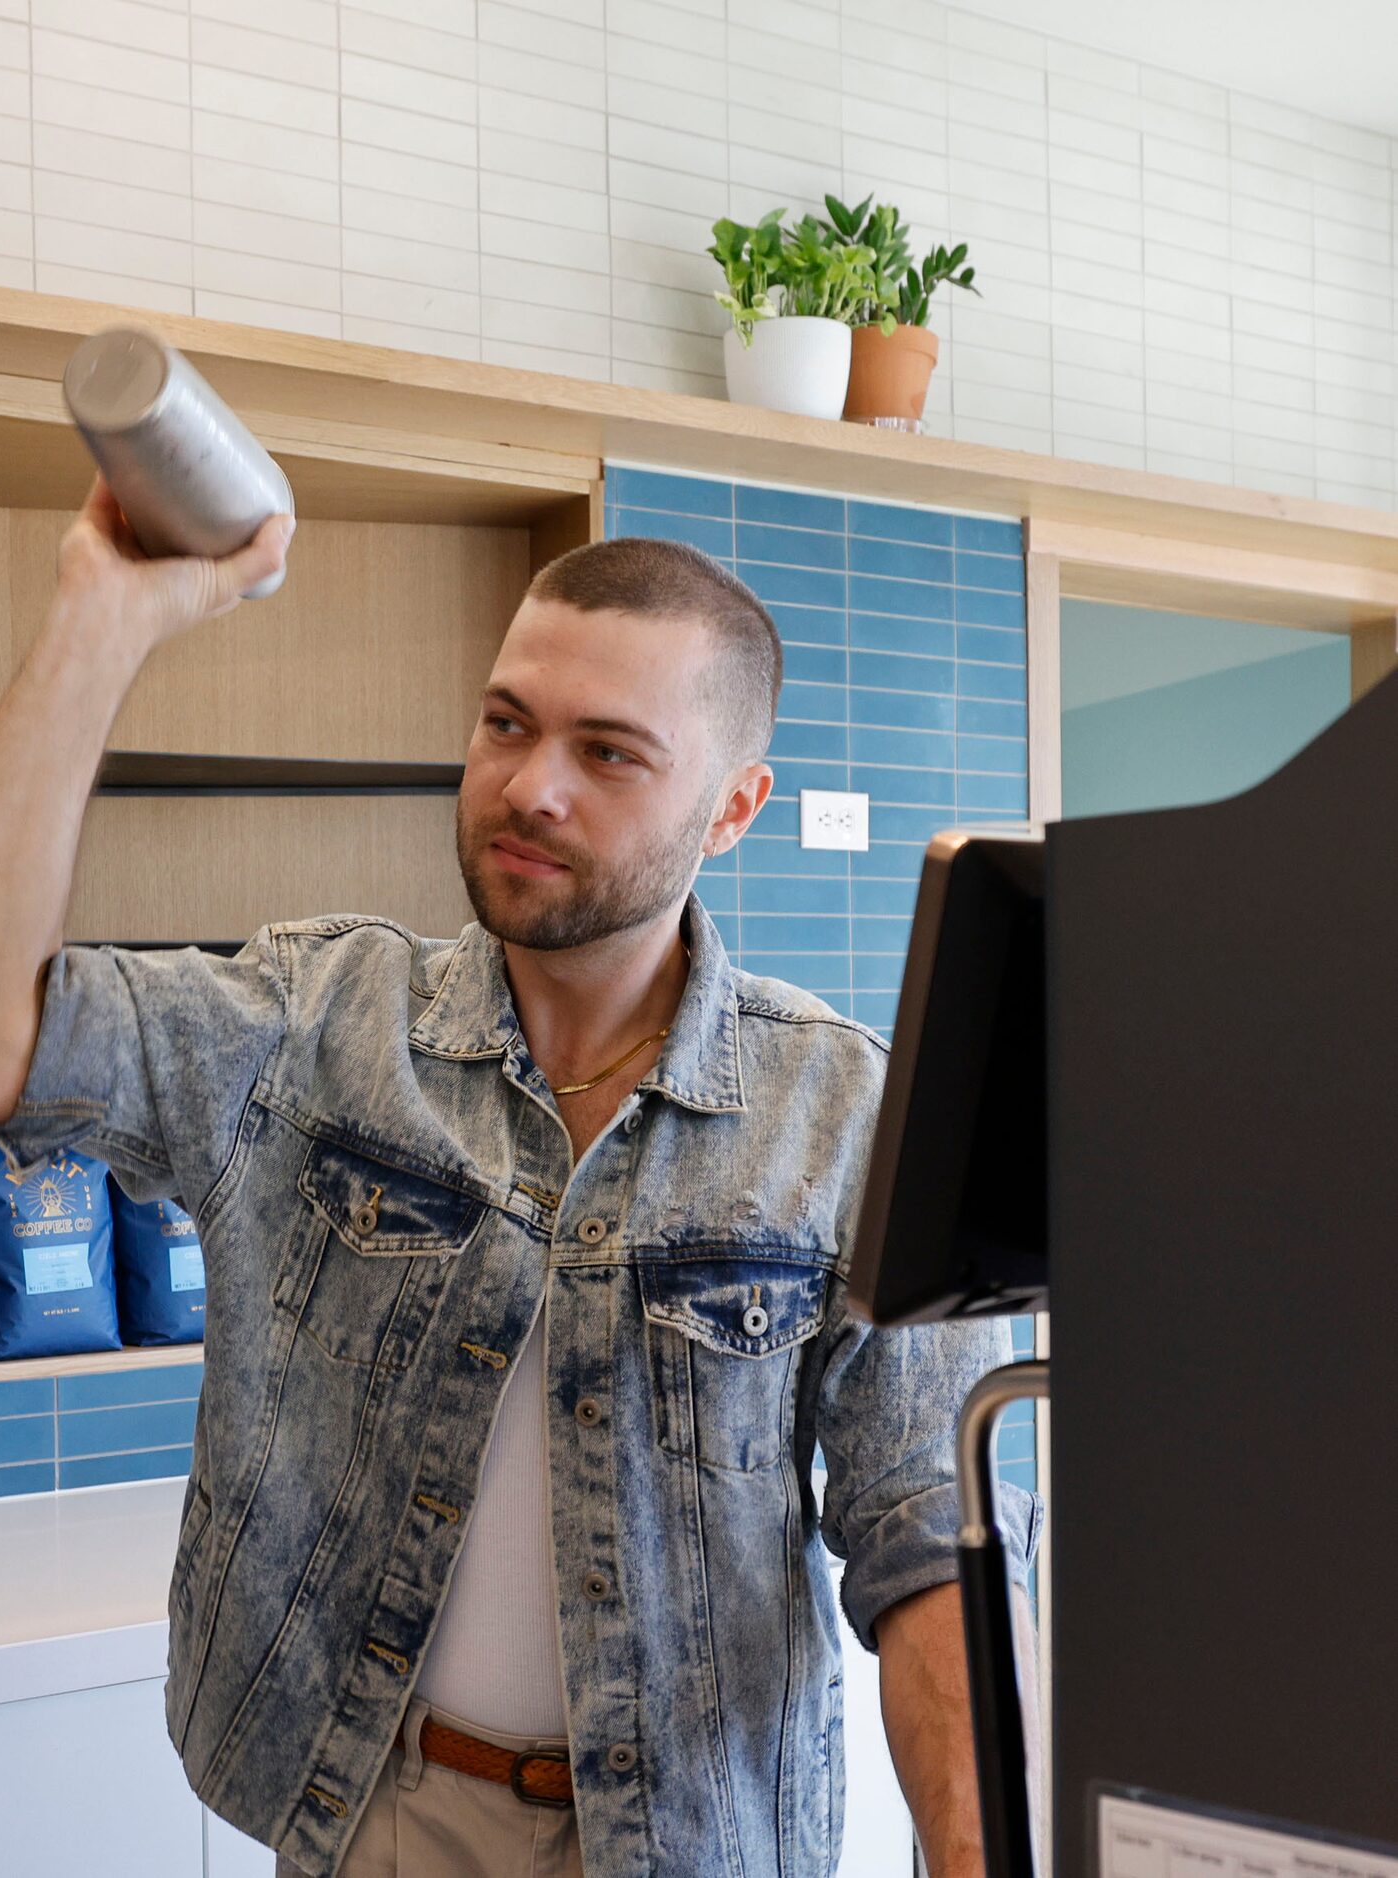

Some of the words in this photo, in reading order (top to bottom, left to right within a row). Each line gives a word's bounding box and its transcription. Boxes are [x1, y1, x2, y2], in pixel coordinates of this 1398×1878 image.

[8, 1193, 18, 1218] TEX
[13, 1219, 73, 1237] COFFEE
[74, 1218, 93, 1231] CO
